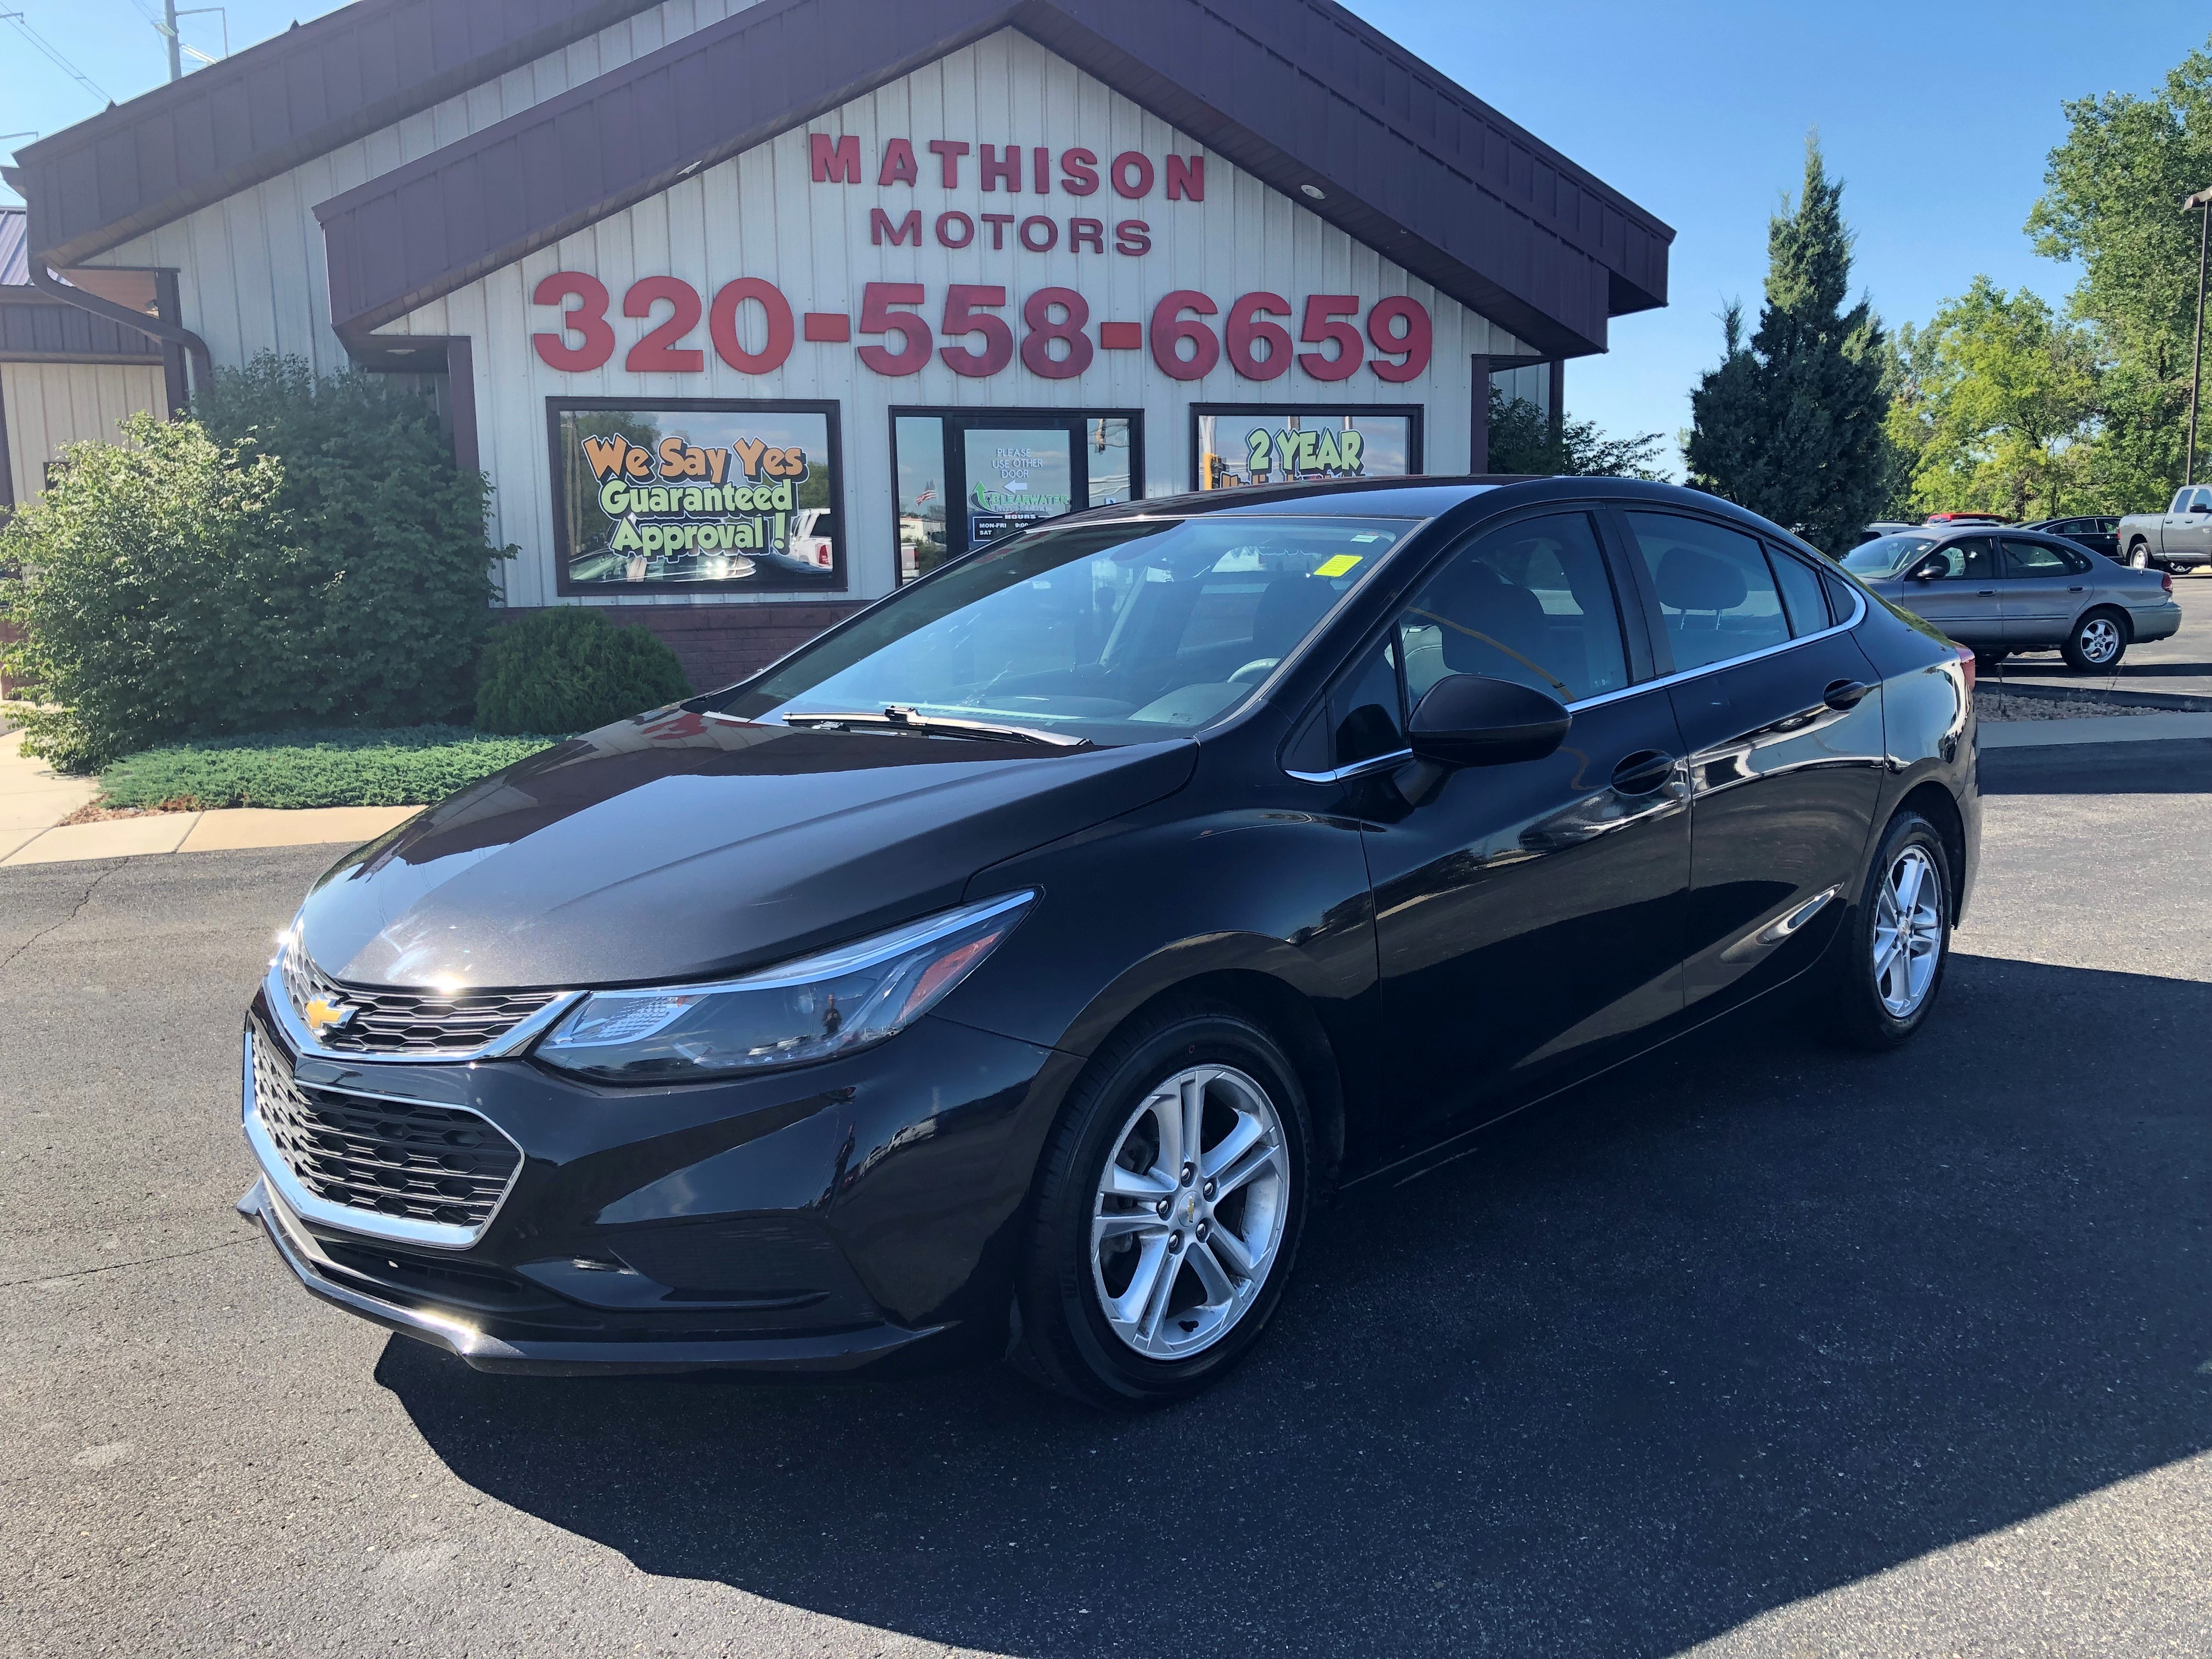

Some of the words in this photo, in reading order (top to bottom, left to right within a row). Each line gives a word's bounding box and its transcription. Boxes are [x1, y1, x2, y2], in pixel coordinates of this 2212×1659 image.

[811, 133, 1204, 201] MATHISON
[870, 208, 1152, 256] MOTORS
[532, 271, 1434, 383] 320-558-6659
[583, 433, 654, 481] We
[658, 437, 730, 483] Say
[733, 437, 806, 481] Yes
[991, 460, 1009, 469] USE
[1013, 458, 1043, 467] OTHER
[996, 448, 1031, 457] PLEASE
[1248, 429, 1273, 473] 2
[1275, 427, 1363, 472] YEAR
[1001, 469, 1029, 478] DOOR
[601, 478, 793, 515] Guaranteed
[991, 493, 1069, 505] CLEARWATER
